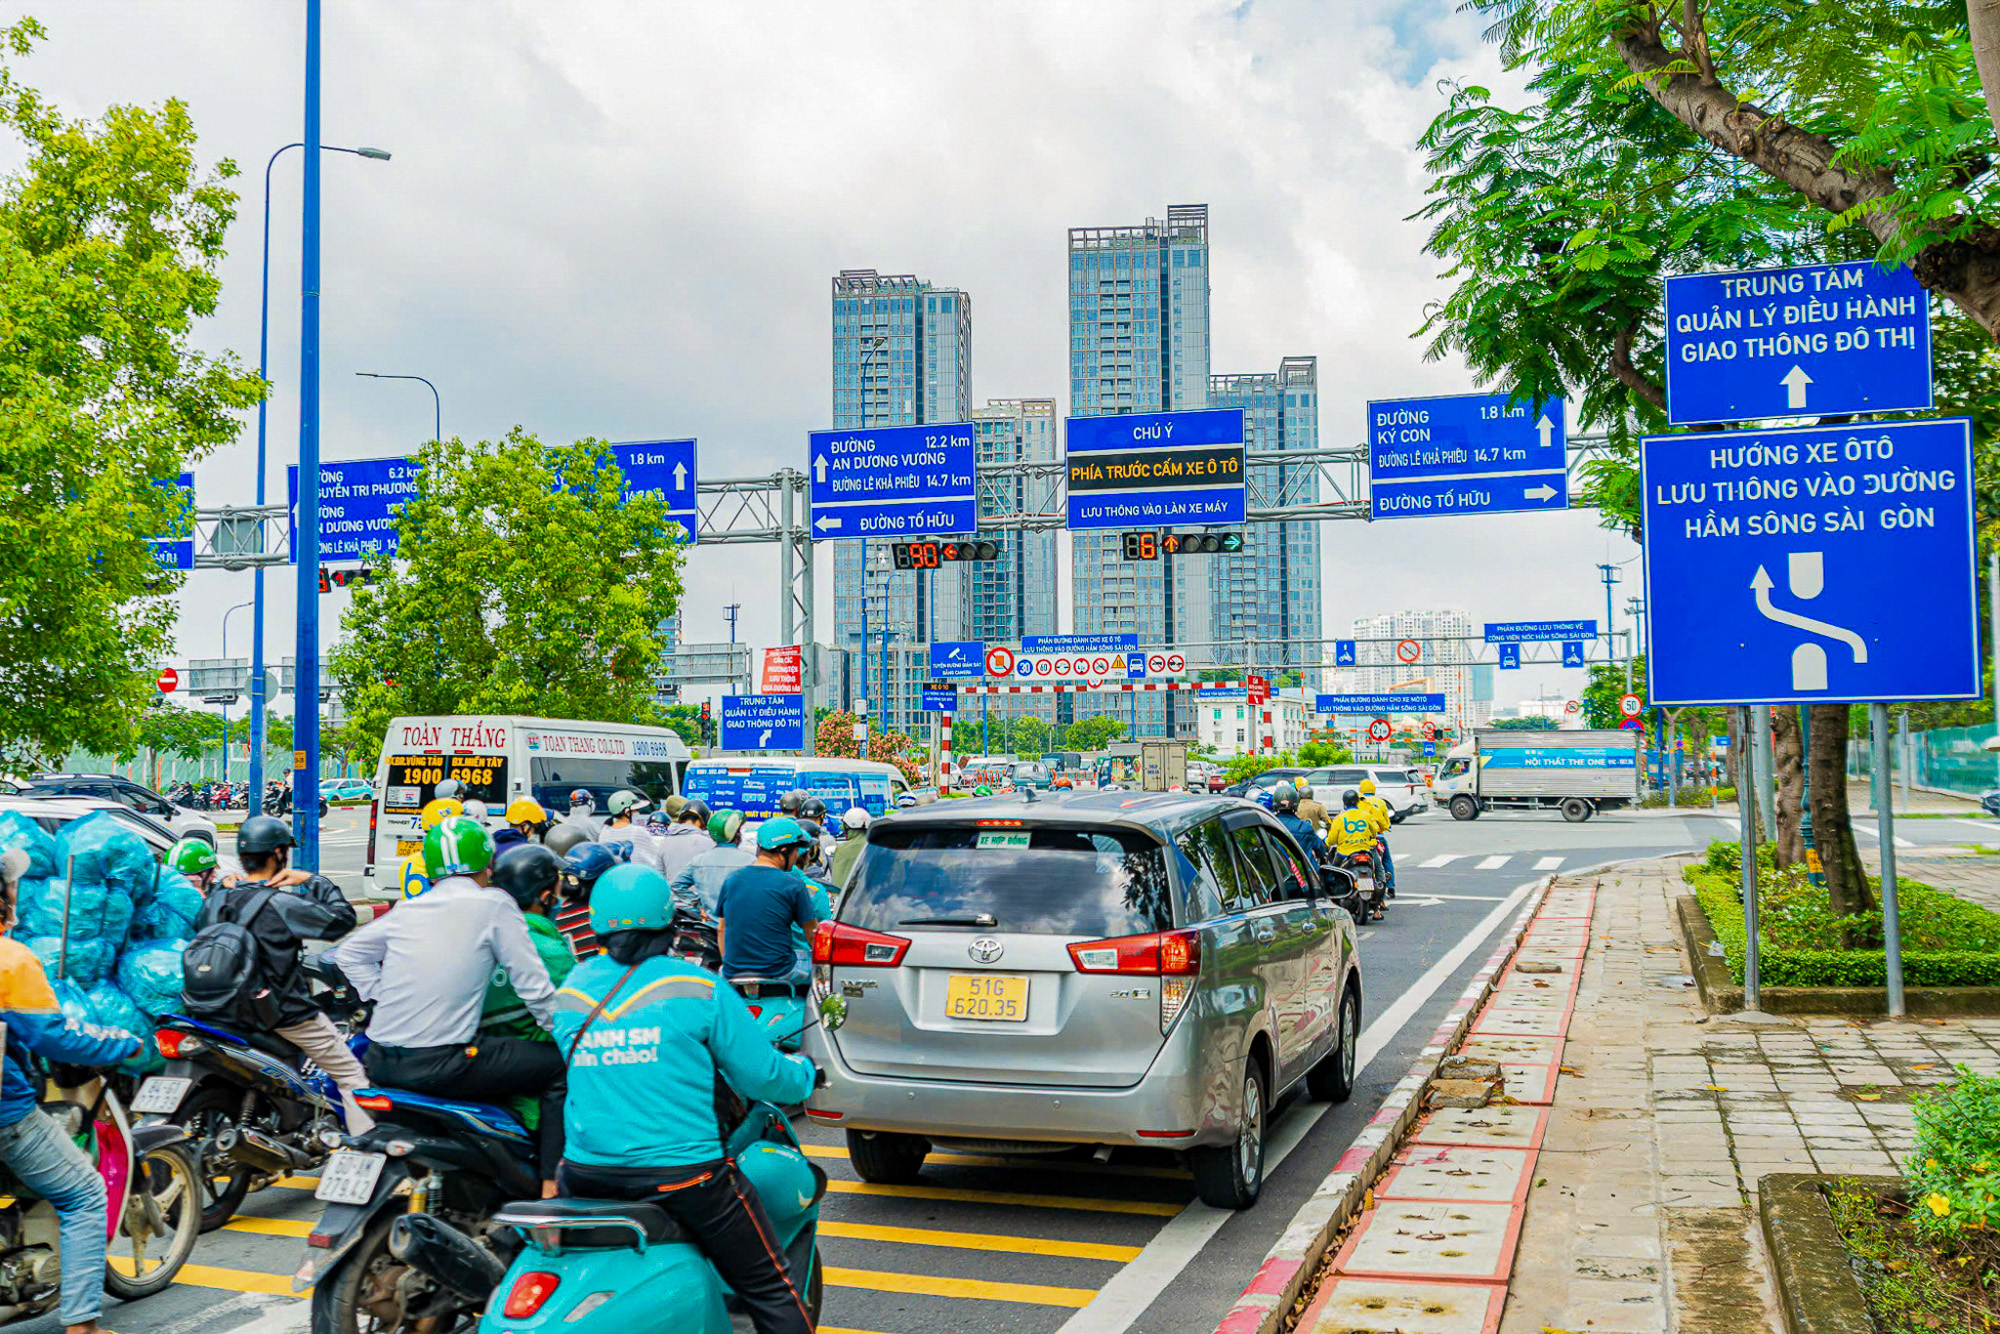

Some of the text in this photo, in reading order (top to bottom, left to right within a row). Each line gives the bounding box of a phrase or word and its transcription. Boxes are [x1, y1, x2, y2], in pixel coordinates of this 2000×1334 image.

[1720, 268, 1864, 299] TRUNG TÂM
[1676, 295, 1916, 333] QUẢN LÝ ĐIỀU HÀNH
[1681, 326, 1916, 363] GIAO THÔNG ĐÔ THỊ
[1376, 410, 1430, 427] ĐƯỜNG
[1480, 406, 1498, 420] 1.8
[1133, 422, 1173, 440] CHÚ Ý
[1378, 428, 1430, 444] KÝ CON
[831, 435, 970, 454] ĐƯỜNG 12.2 km
[1710, 435, 1894, 469] HƯỚNG XE ÔTÔ
[630, 452, 664, 465] 1.8 km
[832, 452, 946, 470] AN DƯƠNG VƯƠNG
[1379, 450, 1408, 468] ĐƯỜNG
[1410, 450, 1420, 466] LÊ
[1422, 447, 1440, 465] KHẢ
[1474, 448, 1499, 462] 14.7
[1503, 448, 1526, 460] km
[319, 469, 344, 483] ỜNG
[389, 467, 404, 478] 6.2
[1072, 457, 1238, 480] PHÍA TRƯỚC CẤM XE Ô TÔ
[352, 482, 418, 496] TRI PHƯƠNG
[832, 476, 862, 492] ĐƯỜNG
[864, 476, 874, 490] LÊ
[876, 473, 893, 490] KHẢ
[926, 474, 948, 487] 14.7
[952, 474, 971, 486] km
[1657, 482, 1706, 504] LƯU
[1713, 477, 1798, 502] THÔNG
[1805, 471, 1856, 497] VÀO
[1380, 488, 1490, 511] ĐƯỜNG TỐ HỮU
[319, 505, 344, 518] ỜNG
[1081, 500, 1228, 518] LƯU THÔNG VÀO LÀN XE MÁY
[326, 520, 363, 534] DƯƠNG
[860, 510, 954, 530] ĐƯỜNG TỐ HỮU
[1686, 503, 1934, 539] HẦM SÔNG SÀI GÒN
[334, 540, 342, 552] LÊ
[1020, 662, 1030, 676] 30
[740, 696, 784, 705] TRUNG TÂM
[1626, 701, 1636, 710] 50
[748, 708, 758, 716] LÝ
[726, 720, 745, 728] GIAO
[747, 719, 773, 728] THÔNG
[402, 722, 442, 746] TOÀN
[451, 720, 506, 748] THẮNG
[1544, 756, 1566, 766] THẤT
[1568, 758, 1585, 766] THE
[1588, 758, 1606, 766] ONE
[404, 768, 493, 785] 1900 6968
[1344, 817, 1366, 833] be
[970, 978, 1004, 997] 51G
[954, 998, 1016, 1017] 620.35
[628, 1026, 660, 1044] SM
[572, 1045, 658, 1066] xin chào!
